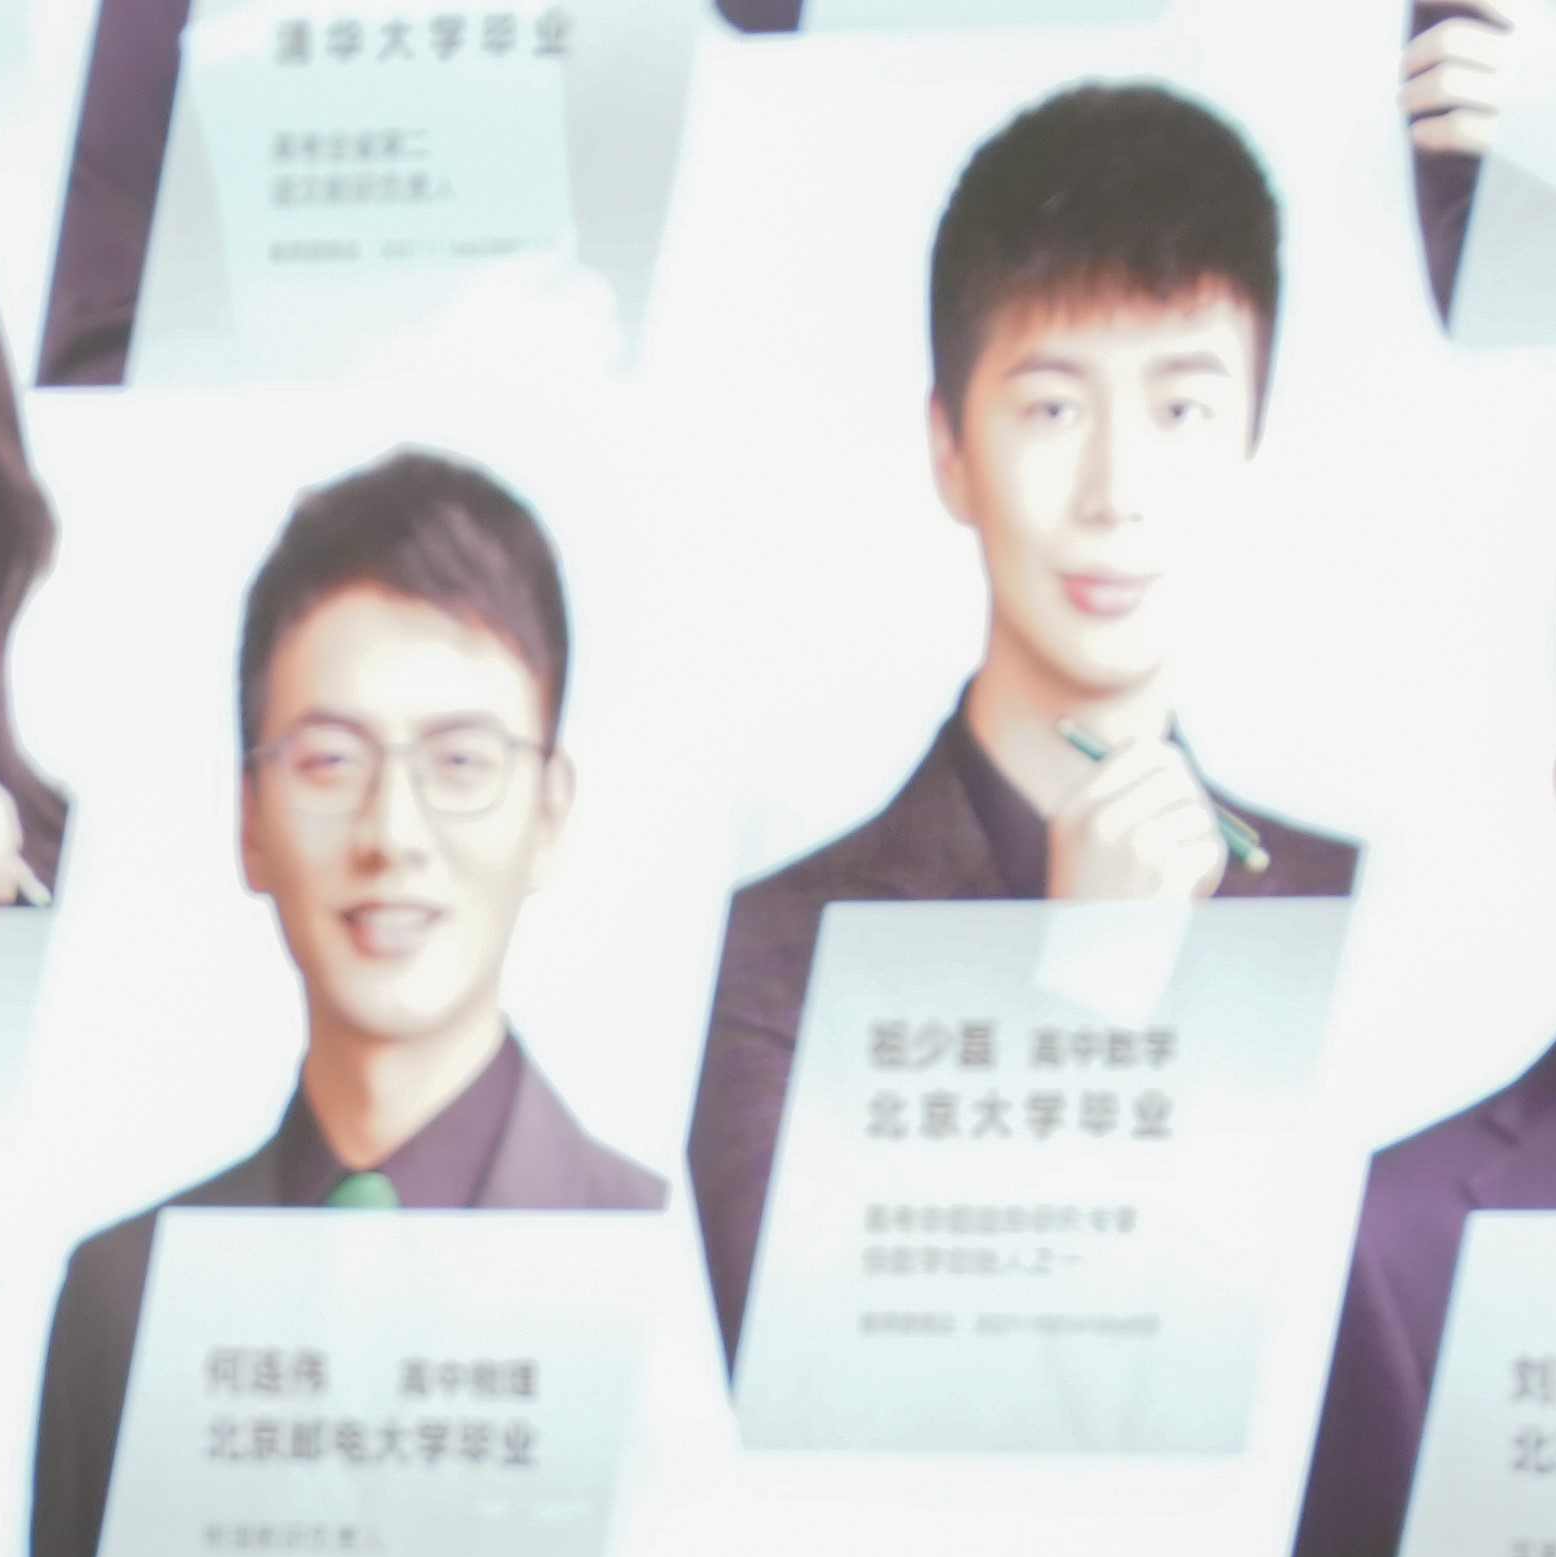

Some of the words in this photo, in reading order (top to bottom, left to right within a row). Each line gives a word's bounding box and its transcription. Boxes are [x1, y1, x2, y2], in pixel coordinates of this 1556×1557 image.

[278, 16, 568, 62] 清华大学毕业
[1033, 1030, 1175, 1065] 高中数学
[867, 1093, 1171, 1139] 北京大学毕业
[208, 1422, 534, 1465] 北京邮电大学毕业
